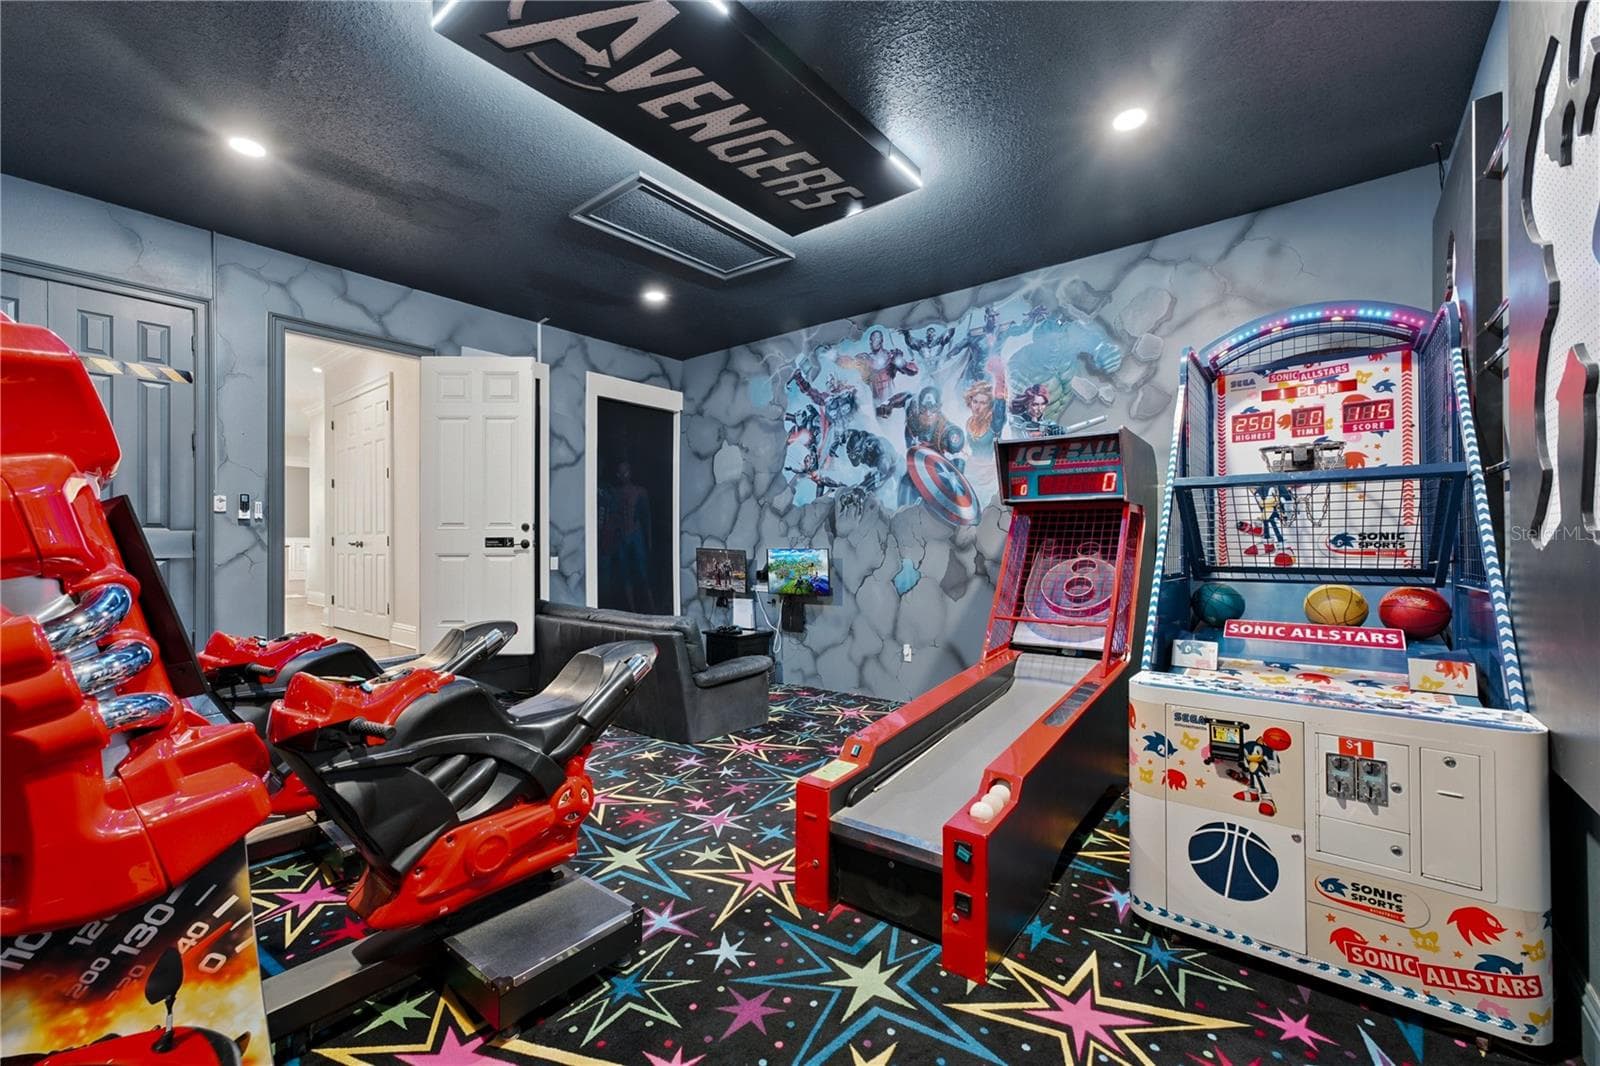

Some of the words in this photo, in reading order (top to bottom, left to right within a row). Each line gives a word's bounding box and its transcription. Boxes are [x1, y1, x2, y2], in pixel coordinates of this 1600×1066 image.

[1270, 371, 1298, 382] SONIC
[1300, 363, 1348, 381] ALLSTARS
[1230, 378, 1256, 389] SEGA
[1235, 415, 1273, 433] 250
[1296, 427, 1320, 436] TIME
[1352, 422, 1385, 431] SCORE
[1235, 432, 1272, 442] HIGHEST
[1015, 445, 1057, 466] ICE
[1102, 472, 1117, 492] 0
[1358, 532, 1405, 540] SONIC
[1358, 541, 1405, 549] SPORTS
[1228, 623, 1286, 637] SONIC
[1290, 627, 1399, 645] ALLSTARS
[1173, 711, 1207, 726] SEGA
[1345, 739, 1363, 756] $1
[1350, 882, 1403, 904] SONIC
[1350, 892, 1404, 913] SPORTS
[68, 913, 119, 946] 12
[111, 902, 176, 956] 130
[176, 921, 209, 955] 40
[198, 952, 228, 974] 0
[1352, 947, 1418, 975] SONIC
[1426, 967, 1540, 997] ALLSTARS
[65, 957, 111, 999] 200
